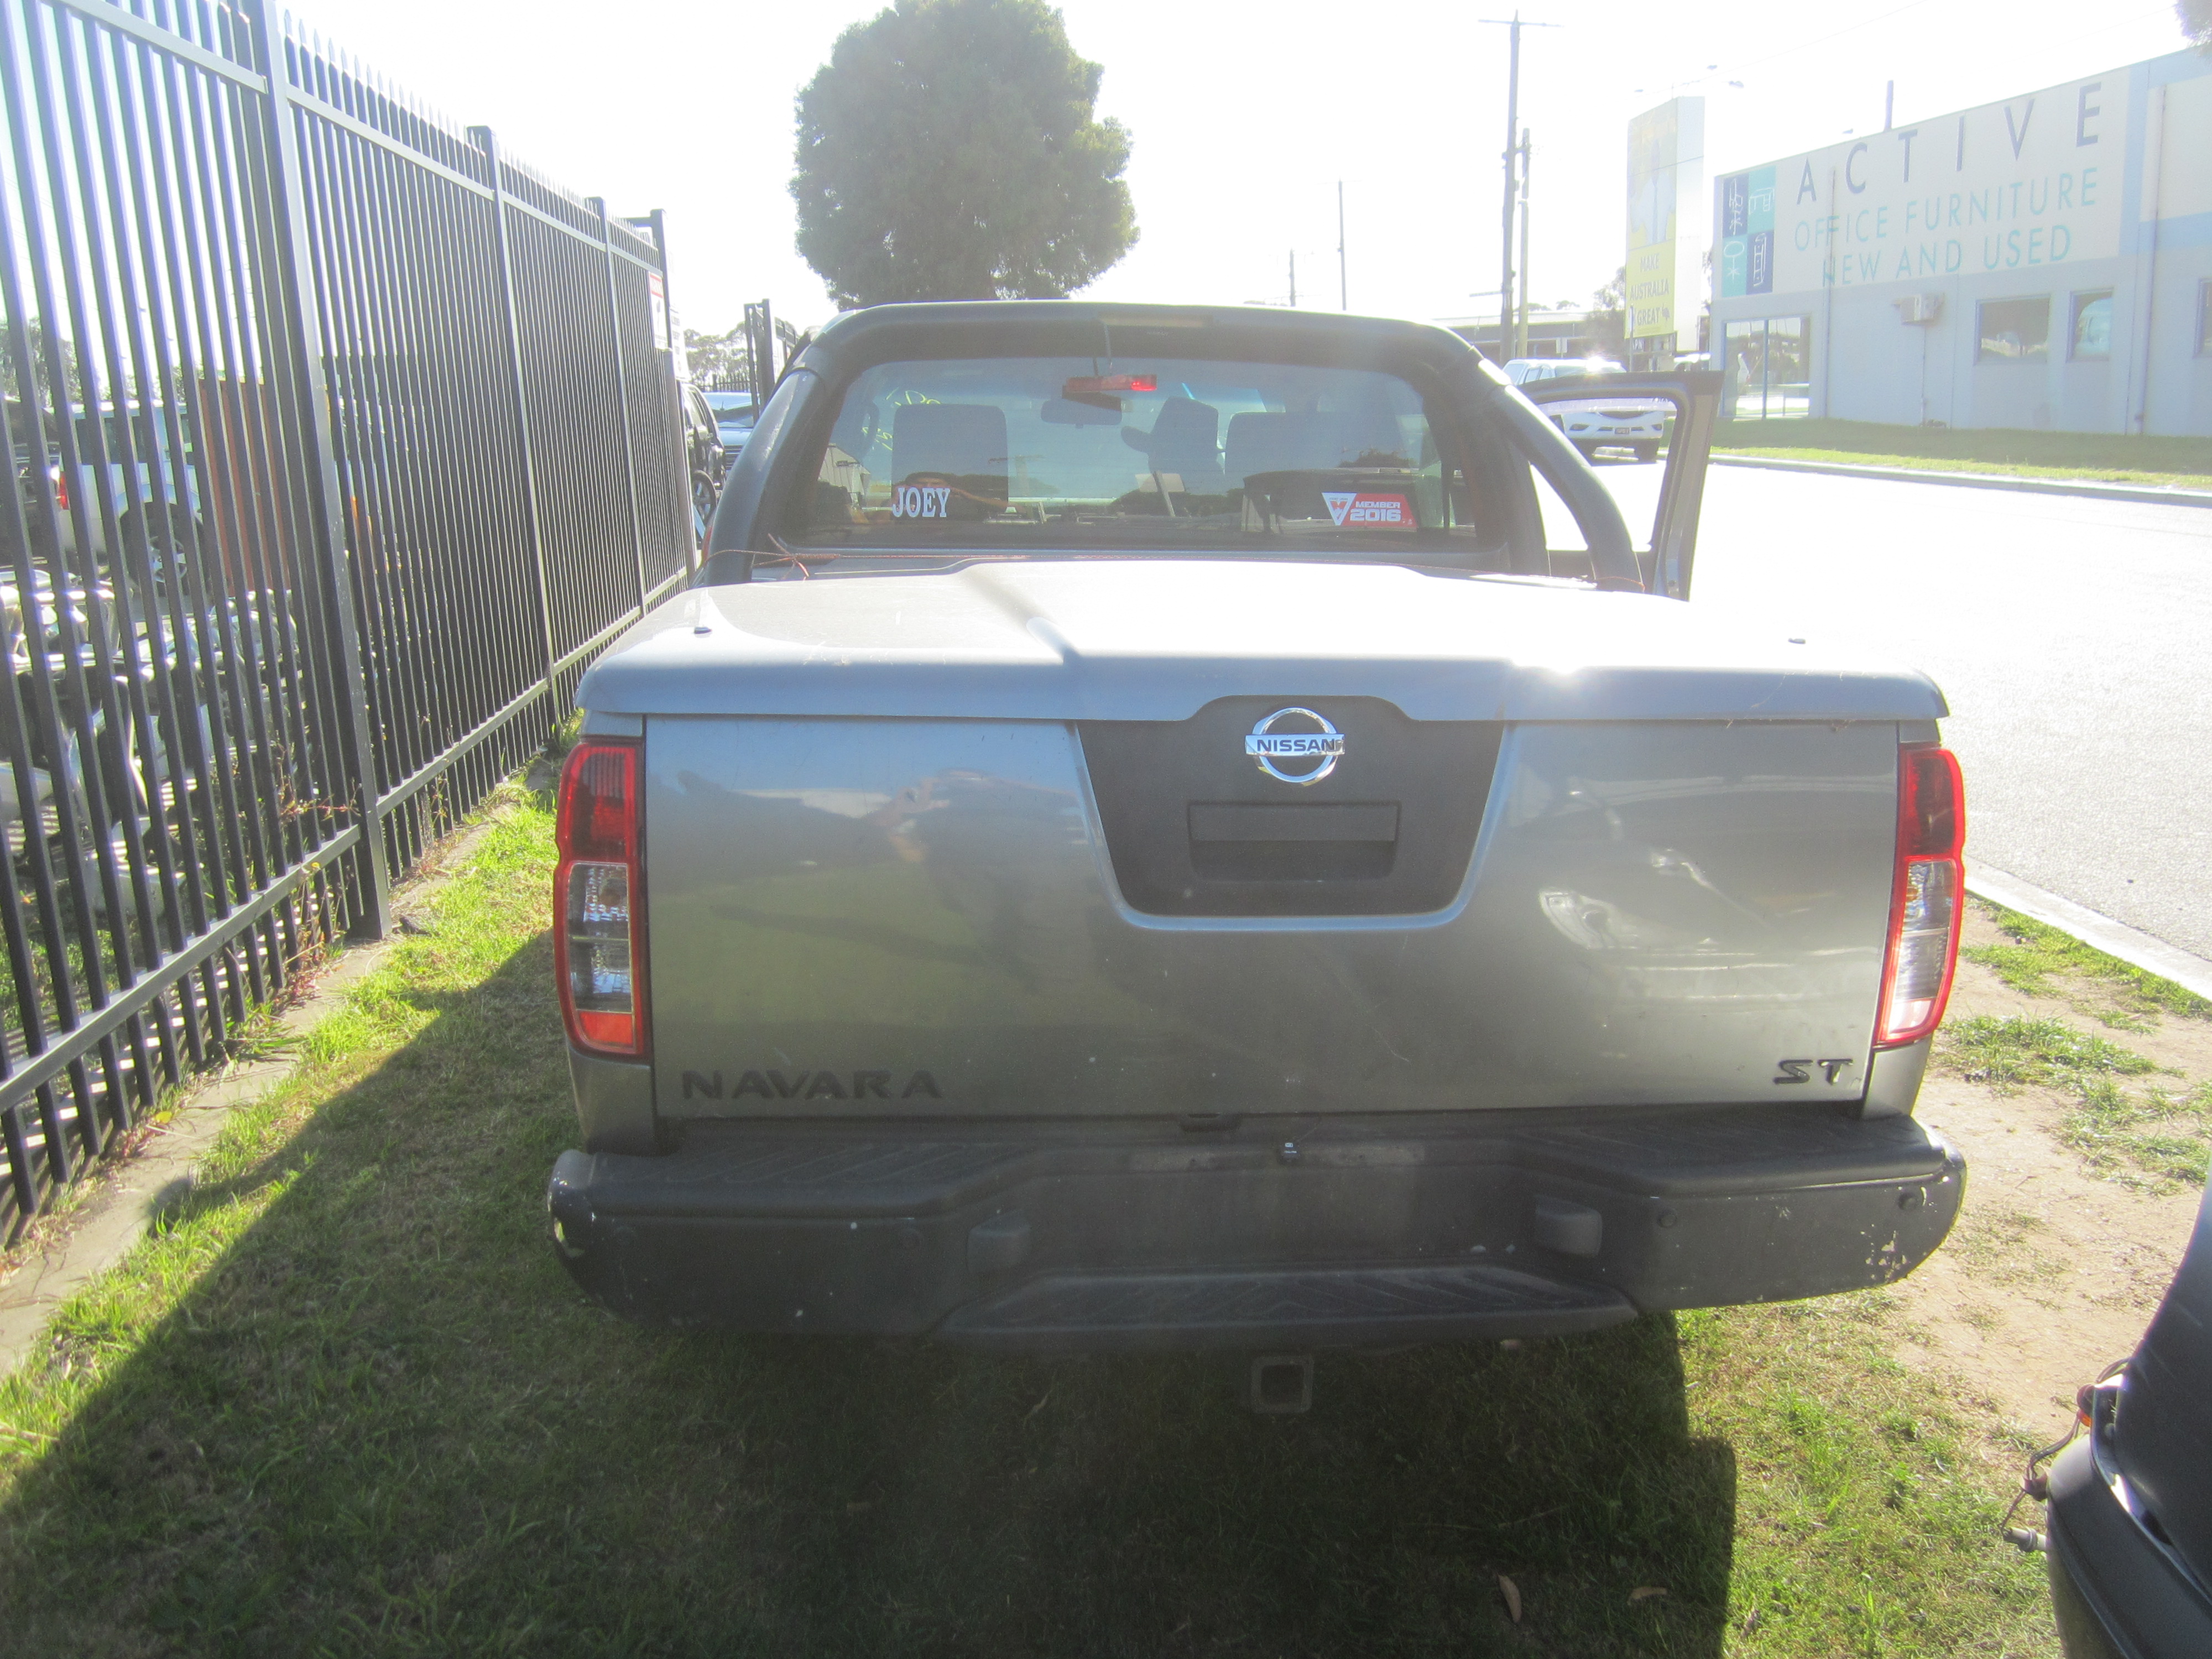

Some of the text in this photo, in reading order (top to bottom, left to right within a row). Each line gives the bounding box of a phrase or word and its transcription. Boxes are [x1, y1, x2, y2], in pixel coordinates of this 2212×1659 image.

[1796, 81, 2102, 205] ACTIVE
[1794, 167, 2098, 252] OFFICE FURNITURE
[1641, 253, 1660, 272] MAKE
[1823, 225, 2072, 288] NEW AND USED
[1630, 278, 1669, 300] AUSTRALIA
[1637, 307, 1660, 326] GREAT
[892, 487, 951, 518] JOEY
[1350, 508, 1401, 521] 2016
[1257, 738, 1335, 752] NISSAN
[681, 1070, 942, 1100] NAVARA
[1773, 1058, 1854, 1086] ST
